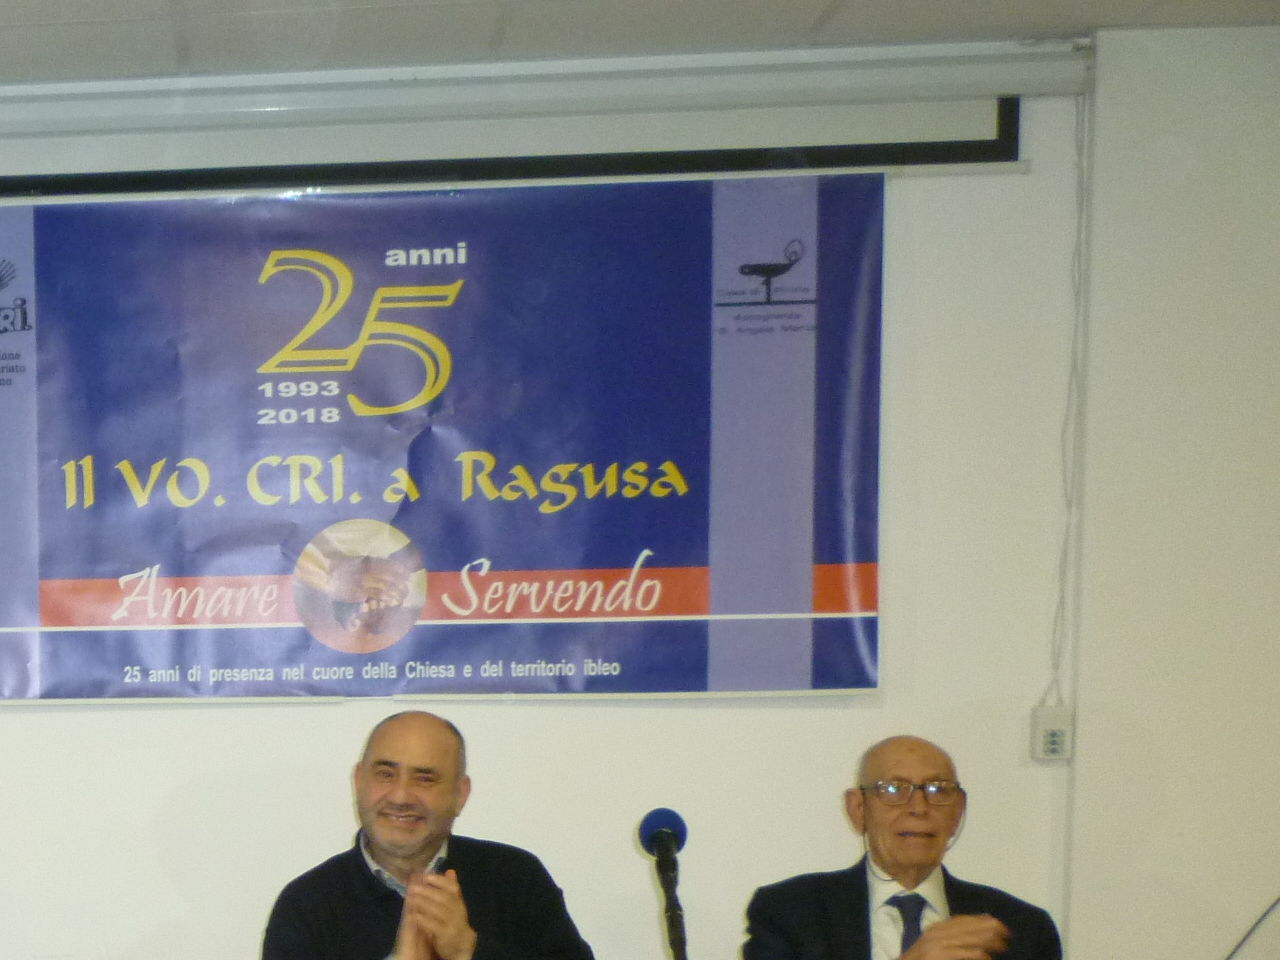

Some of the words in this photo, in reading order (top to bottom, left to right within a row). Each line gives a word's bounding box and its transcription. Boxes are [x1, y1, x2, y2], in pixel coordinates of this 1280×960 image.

[385, 242, 467, 266] anni
[256, 249, 464, 416] 25
[257, 381, 341, 398] 1993
[256, 407, 341, 425] 2018
[61, 454, 96, 509] Il
[115, 456, 225, 509] VO.
[246, 454, 363, 506] CRI.
[384, 467, 420, 503] a
[454, 450, 690, 514] Ragusa
[110, 563, 279, 620] Amare
[442, 548, 662, 617] Servendo
[123, 666, 141, 683] 25
[148, 665, 180, 682] anni
[187, 664, 202, 682] di
[209, 665, 274, 685] presenza
[282, 663, 304, 681] nel
[312, 665, 354, 680] cuore
[362, 662, 397, 680] della
[404, 661, 455, 679] Chiesa
[463, 665, 473, 678] e
[480, 660, 503, 678] del
[510, 659, 576, 677] territorio
[583, 658, 620, 676] ibleo
